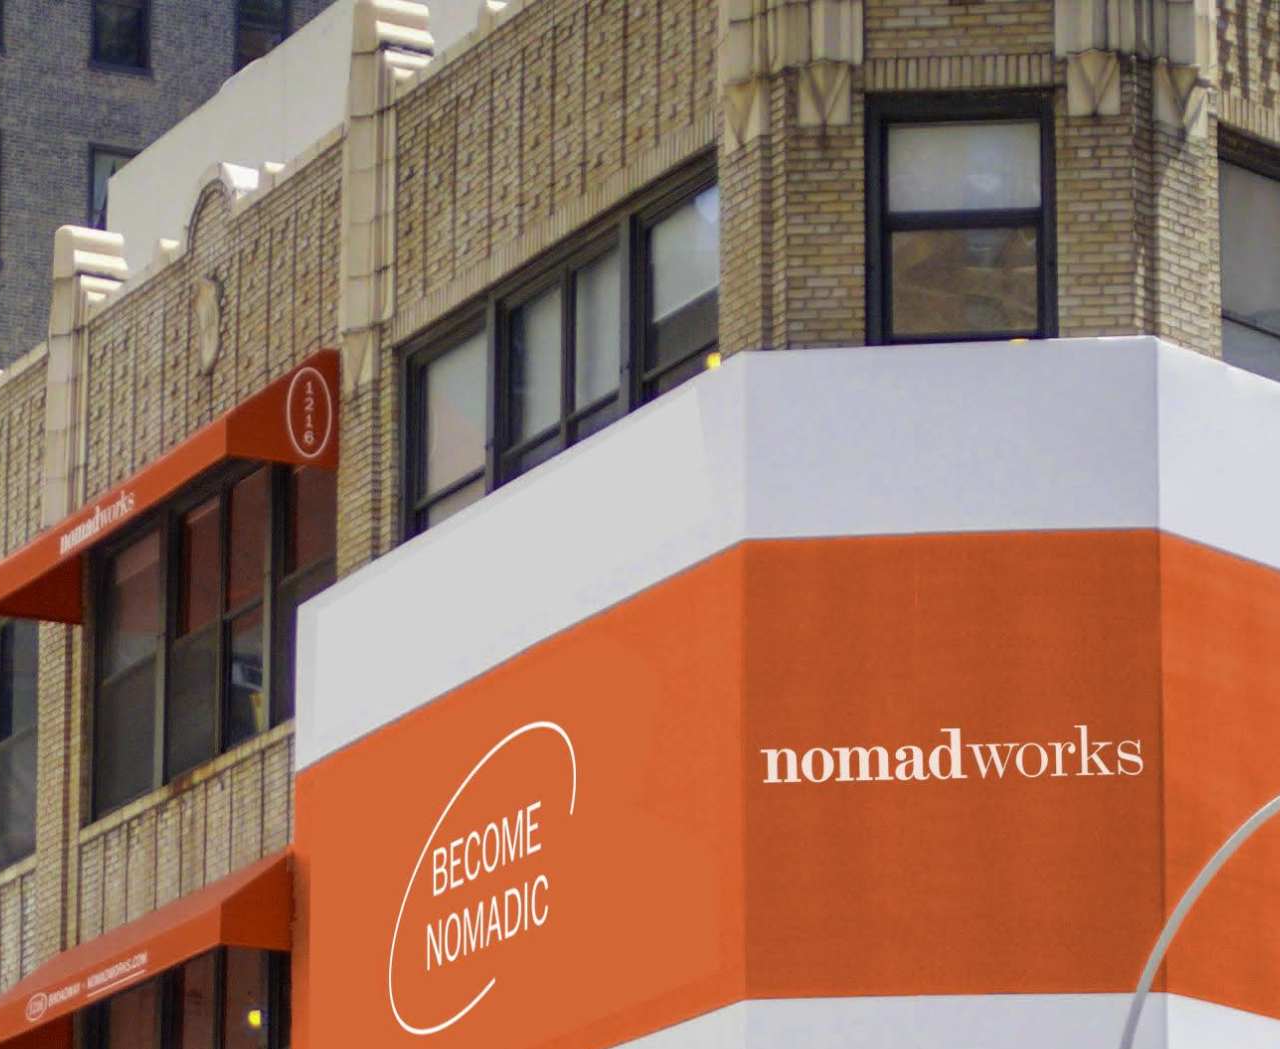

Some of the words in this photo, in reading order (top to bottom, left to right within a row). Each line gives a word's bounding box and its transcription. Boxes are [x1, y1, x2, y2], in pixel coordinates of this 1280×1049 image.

[303, 381, 315, 444] 1216
[60, 491, 136, 558] nomadworks
[760, 726, 1145, 784] nomadworks
[431, 800, 543, 897] BECOME
[425, 874, 550, 972] NOMADIC
